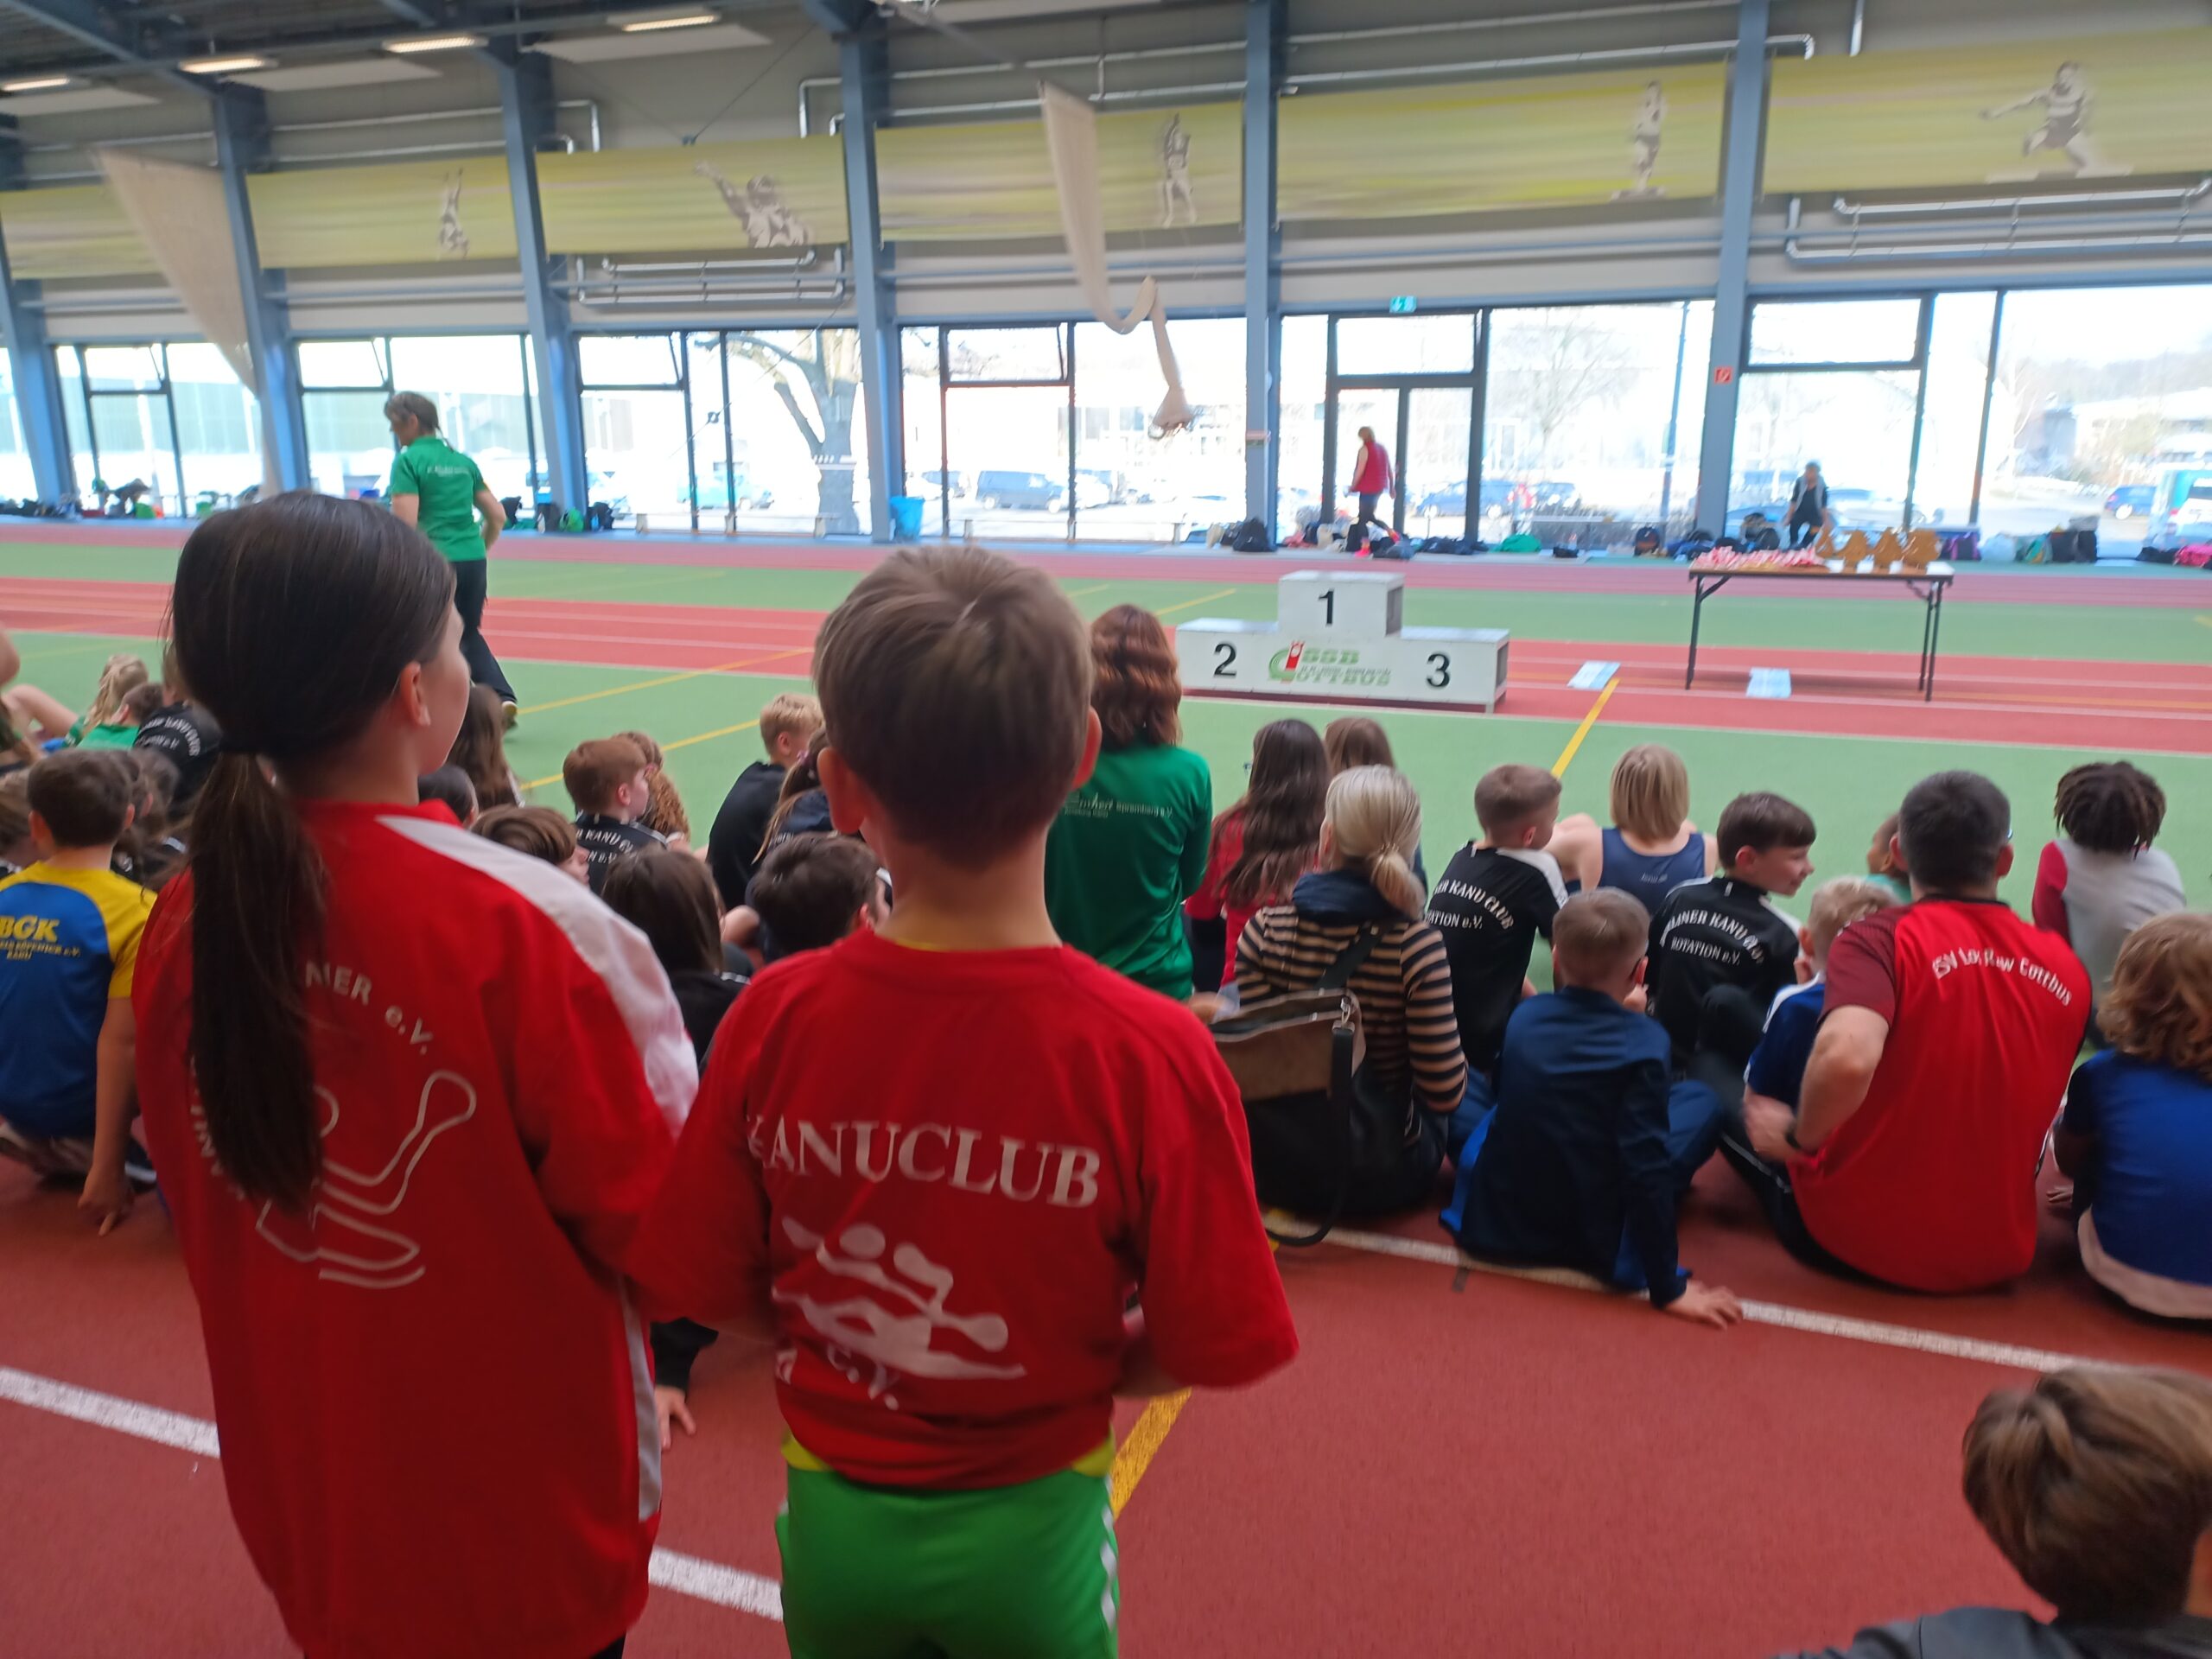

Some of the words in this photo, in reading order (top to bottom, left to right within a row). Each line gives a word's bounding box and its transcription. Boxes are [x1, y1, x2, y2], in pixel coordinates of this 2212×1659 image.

[1318, 588, 1335, 626] 1
[1213, 643, 1237, 677] 2
[1426, 654, 1452, 688] 3
[1448, 880, 1486, 904] KANU
[1709, 912, 1748, 941] KANU
[1670, 936, 1721, 961] ROTATION
[2019, 957, 2072, 1007] Cottbus
[305, 959, 372, 1006] NER
[385, 1005, 435, 1056] e.V.
